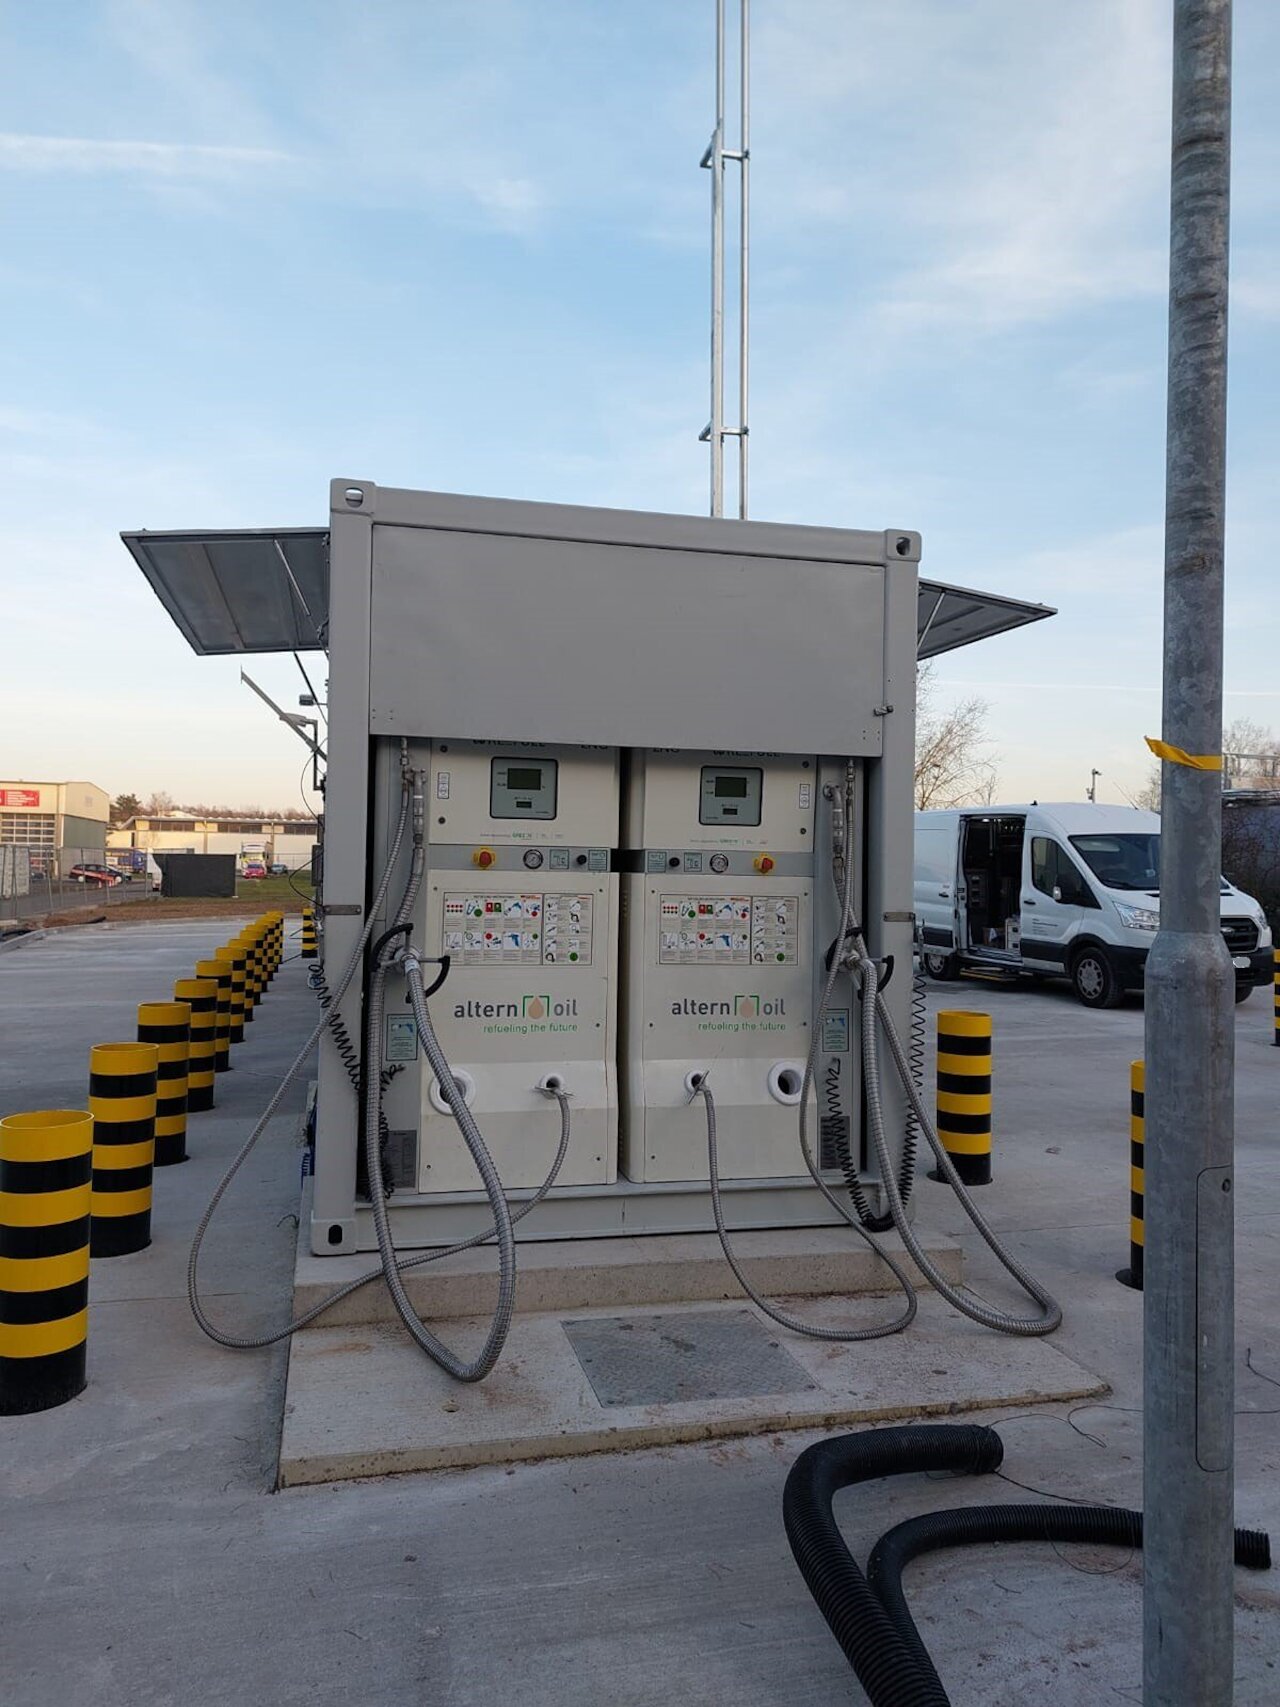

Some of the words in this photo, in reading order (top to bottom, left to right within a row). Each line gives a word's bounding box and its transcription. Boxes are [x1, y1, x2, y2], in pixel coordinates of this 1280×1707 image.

[454, 1000, 518, 1018] altern
[554, 999, 578, 1016] oil
[671, 998, 730, 1015] altern
[763, 998, 786, 1015] oil
[483, 1024, 528, 1034] refueling
[530, 1023, 546, 1032] the
[549, 1023, 578, 1032] future
[698, 1022, 739, 1032] refueling
[742, 1021, 757, 1030] the
[760, 1021, 786, 1030] future
